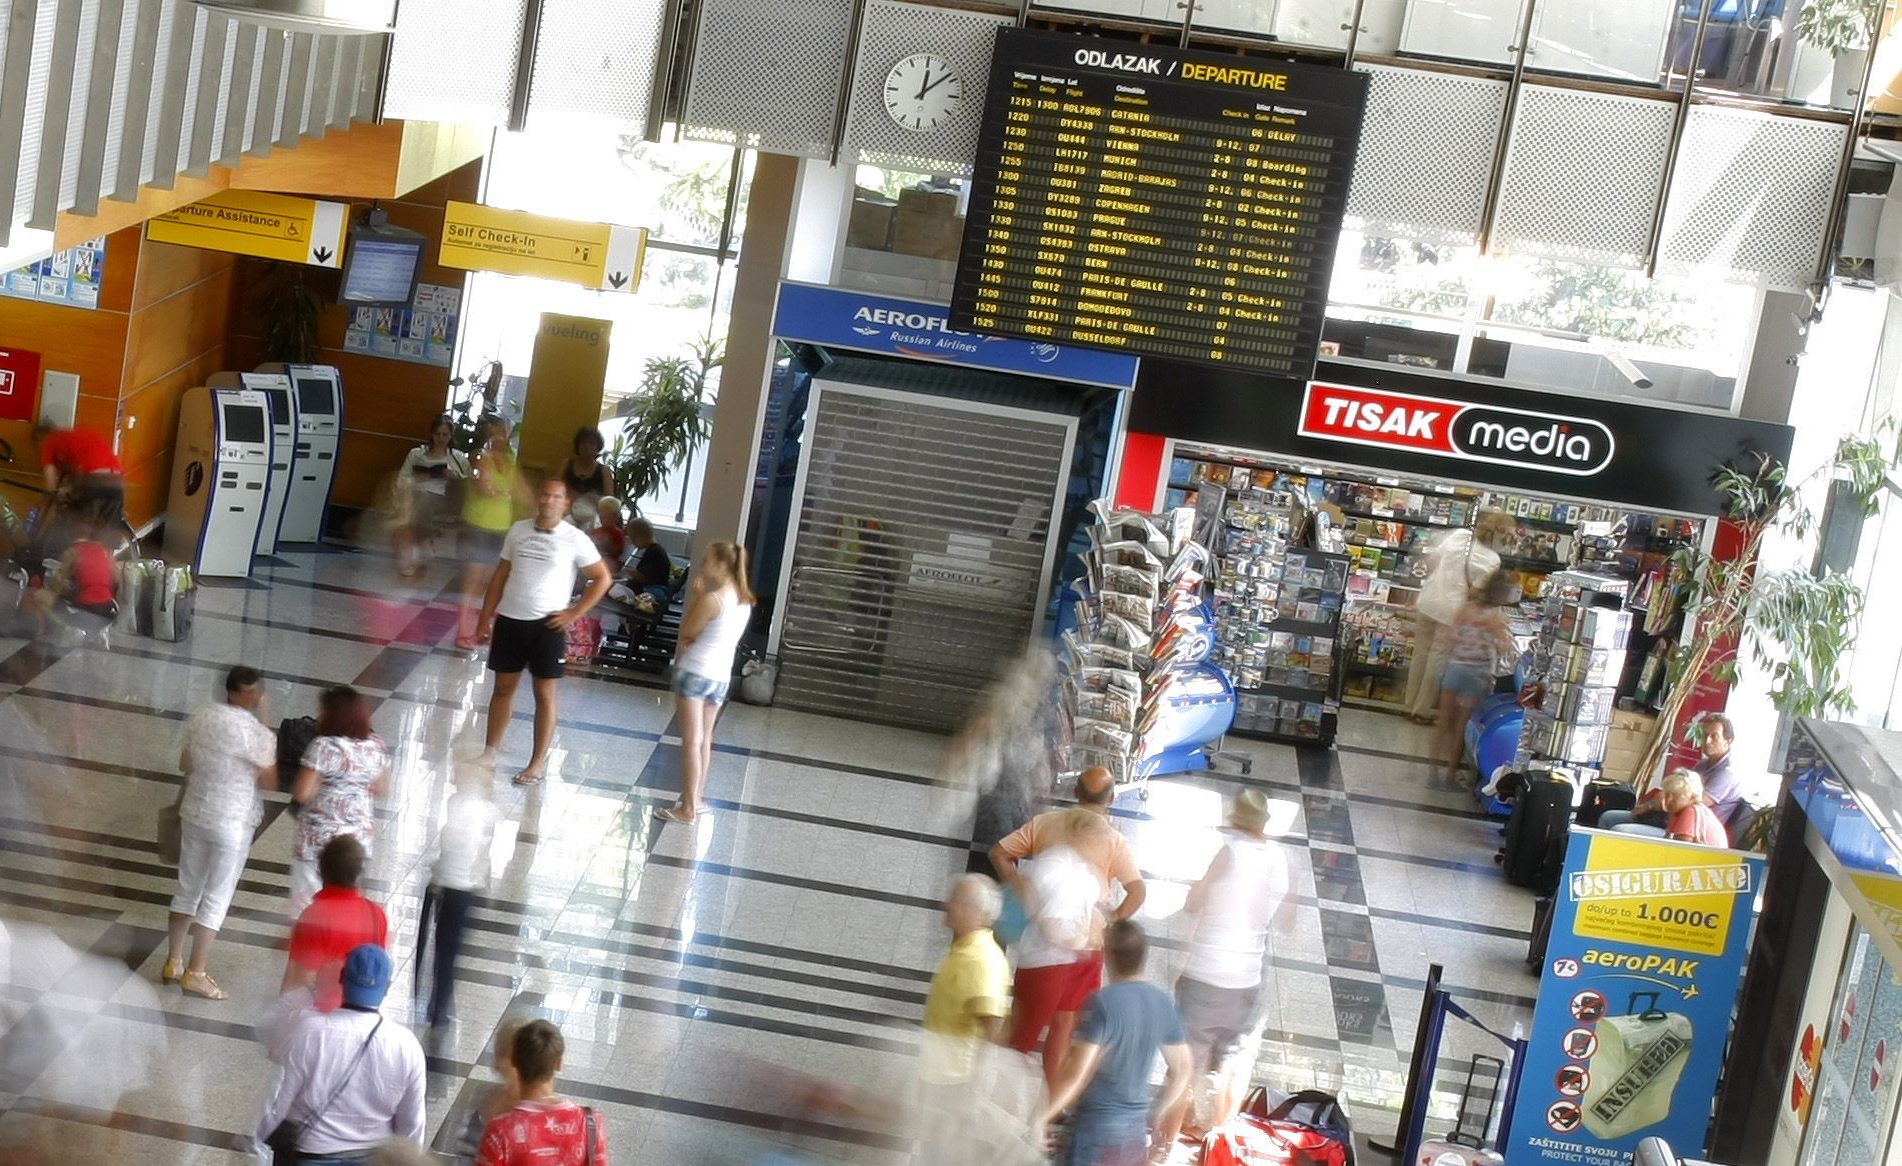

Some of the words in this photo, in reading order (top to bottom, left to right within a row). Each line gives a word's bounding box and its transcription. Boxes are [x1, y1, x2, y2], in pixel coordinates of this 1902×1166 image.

[1074, 48, 1161, 75] ODLAZAK
[1167, 60, 1178, 78] /
[1181, 62, 1288, 92] DEPARTURE
[1007, 110, 1029, 122] 1220
[1107, 123, 1180, 142] ARN-STOCKHOLM
[1247, 142, 1260, 153] 07
[1009, 95, 1032, 107] 1215
[1036, 99, 1059, 111] 1300
[1110, 108, 1150, 123] CATANIA
[1266, 129, 1296, 142] DELAY
[1002, 140, 1024, 152] 1250
[1054, 147, 1088, 160] LH1717
[1102, 153, 1137, 167] MUNICH
[1210, 168, 1228, 179] 2-8
[1242, 172, 1255, 183] 04
[1258, 174, 1304, 189] Check-in
[1004, 125, 1027, 137] 1230
[1105, 138, 1139, 152] VIENNA
[1212, 153, 1231, 164] 2-8
[1261, 159, 1307, 174] Boarding
[997, 170, 1019, 181] 1300
[1097, 183, 1132, 197] ZAGREB
[1204, 197, 1223, 209] 2-8
[1237, 202, 1249, 212] 02
[1253, 204, 1299, 219] Check-in
[999, 155, 1022, 167] 1255
[1099, 168, 1177, 187] MADRID-BARAJAS
[1255, 189, 1302, 204] Check-in
[216, 209, 281, 228] Assistance
[992, 199, 1014, 211] 1330
[1092, 213, 1126, 226] PRAGUE
[1231, 232, 1244, 242] 07
[1247, 234, 1293, 249] Check-in
[995, 184, 1017, 196] 1305
[1094, 198, 1150, 214] COPENHAGEN
[1250, 219, 1296, 234] Check-in
[447, 224, 474, 238] Self
[478, 229, 536, 248] Check-In
[985, 243, 1007, 255] 1350
[1084, 257, 1108, 269] BERN
[987, 229, 1010, 240] 1340
[1087, 242, 1126, 256] OSTRAVA
[1242, 263, 1288, 278] Check-in
[990, 214, 1012, 226] 1330
[1089, 227, 1161, 246] ARN-STOCKHOLM
[1196, 242, 1215, 253] 2-8
[1228, 246, 1241, 257] 04
[1244, 249, 1290, 264] Check-in
[980, 273, 1002, 284] 1445
[1079, 286, 1128, 302] FRANKFURT
[1186, 301, 1204, 312] 2-8
[1218, 305, 1230, 316] 04
[1234, 307, 1279, 322] Check-in
[982, 258, 1005, 270] 1430
[1082, 271, 1126, 286] PARIS-DE
[1129, 278, 1163, 291] GAULLE
[1188, 286, 1207, 297] 2-8
[1236, 293, 1282, 308] Check-in
[854, 306, 984, 338] AEROFL
[975, 302, 997, 313] 1520
[1074, 315, 1118, 330] PARIS-DE
[1121, 322, 1155, 335] GAULLE
[978, 287, 1000, 299] 1500
[1077, 301, 1132, 317] DOMODEDOVO
[1215, 320, 1228, 330] 07
[543, 324, 599, 346] vueling
[889, 331, 931, 346] Russian
[935, 338, 978, 353] Airlines
[973, 316, 995, 328] 1525
[1072, 330, 1126, 346] DUSSELDORF
[1322, 397, 1440, 442] TISAK
[1468, 419, 1592, 463] media
[1573, 866, 1747, 896] OSIGURANO
[1587, 903, 1618, 917] do/up
[1620, 907, 1632, 917] to
[1636, 903, 1720, 929] 1.000€
[1581, 948, 1699, 979] aeroPAK
[1528, 1137, 1582, 1153] ZAŠTITITE
[1584, 1146, 1618, 1158] SVOJU
[1541, 1150, 1582, 1163] PROTECT
[1585, 1155, 1610, 1166] YOUR
